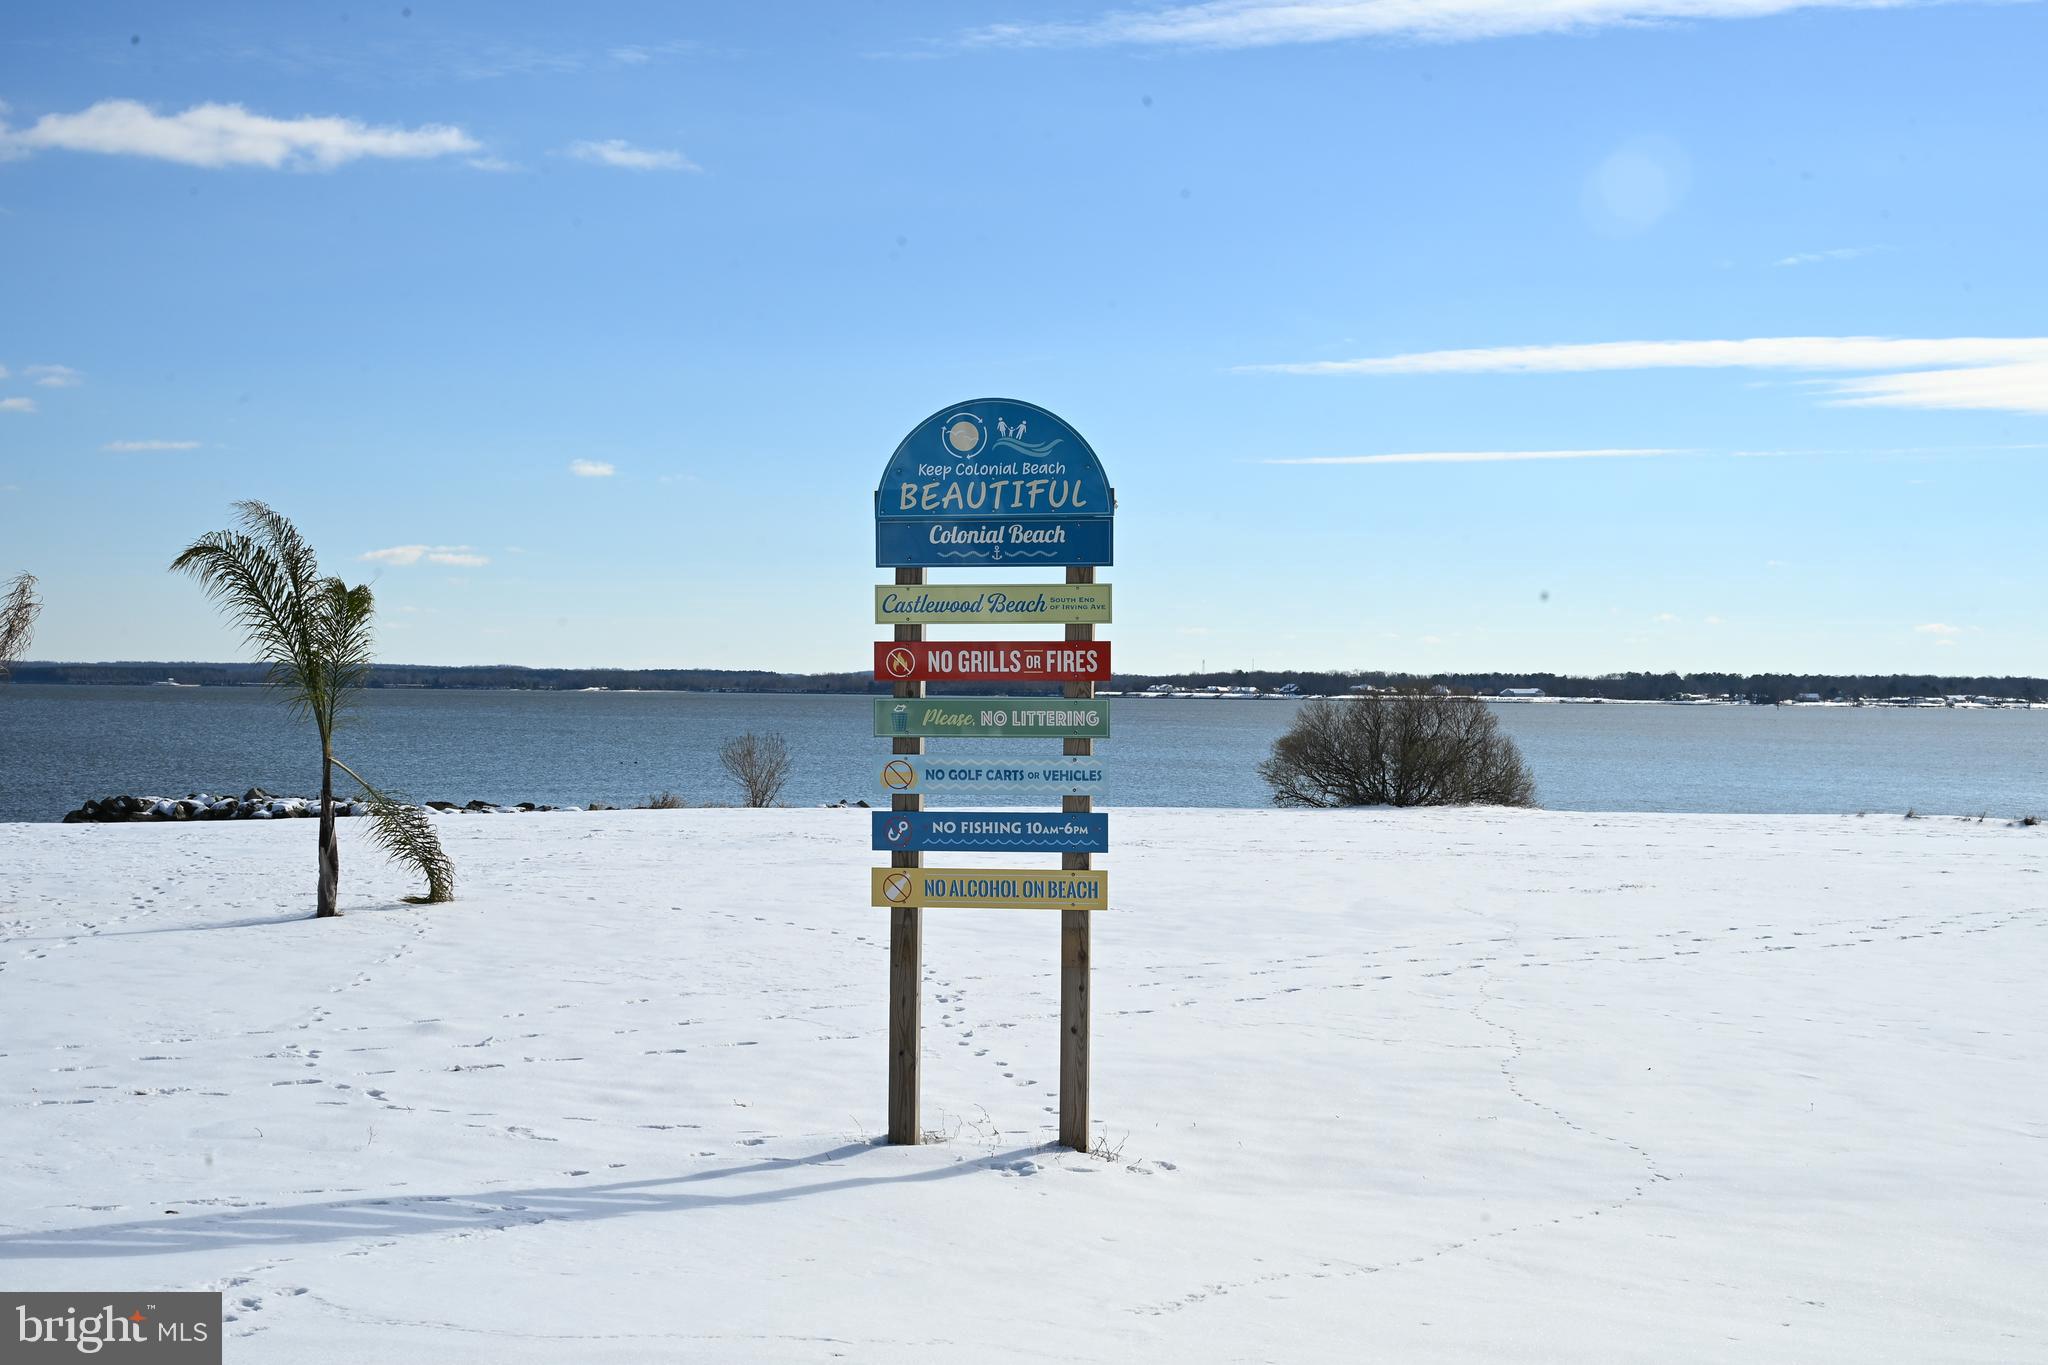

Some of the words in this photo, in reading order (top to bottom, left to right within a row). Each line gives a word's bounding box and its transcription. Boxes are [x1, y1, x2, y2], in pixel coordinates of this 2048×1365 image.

[918, 463, 951, 480] Keep
[956, 462, 1017, 476] Colonial
[1022, 462, 1065, 475] Beach
[900, 479, 1087, 510] BEAUTIFUL
[929, 524, 1004, 544] Colonial
[1008, 524, 1065, 543] Beach
[882, 593, 984, 613] Castlewood
[987, 592, 1047, 614] Beach
[928, 651, 953, 672] NO
[958, 651, 1021, 673] GRILLS
[1026, 655, 1041, 669] OR
[1046, 650, 1098, 673] FIRES
[980, 710, 1007, 726] NO
[1012, 711, 1100, 727] LITTERING
[926, 769, 945, 780] NO
[950, 769, 982, 781] GOLF
[986, 769, 1024, 781] CARTS
[1042, 770, 1102, 781] VEHICLES
[932, 822, 956, 833] NO
[961, 822, 1022, 834] FISHING
[924, 879, 945, 897] NO
[949, 879, 1019, 898] ALCOHOL
[1023, 880, 1045, 898] ON
[1048, 881, 1099, 899] BEACH
